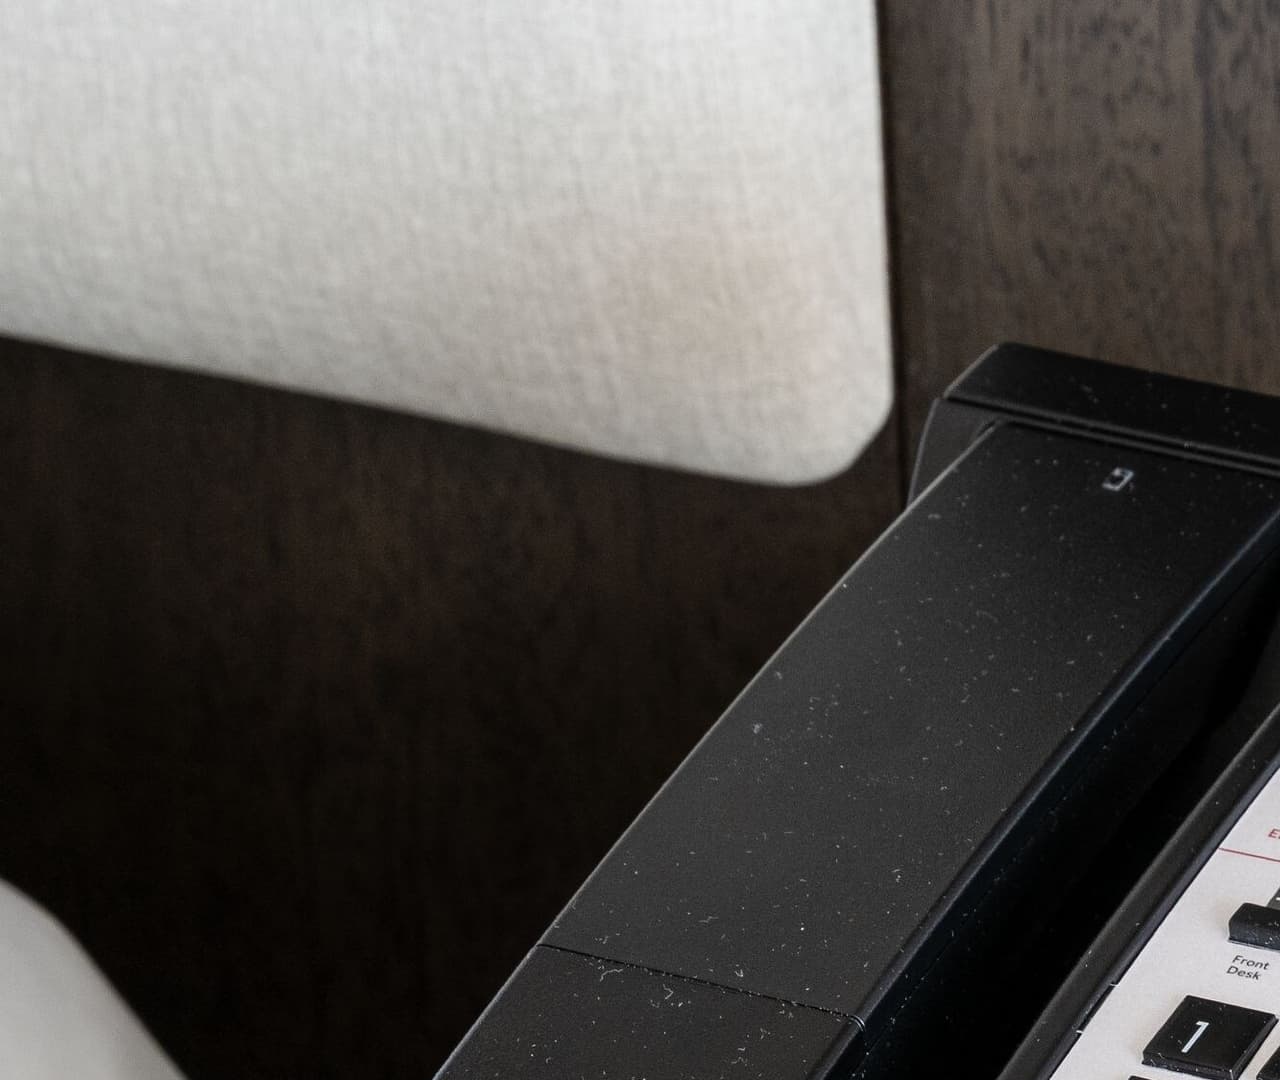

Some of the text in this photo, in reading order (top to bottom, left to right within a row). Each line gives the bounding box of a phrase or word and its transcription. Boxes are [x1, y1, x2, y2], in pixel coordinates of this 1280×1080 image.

[1232, 955, 1270, 970] Front
[1226, 965, 1262, 981] Desk
[1181, 1020, 1210, 1053] 1
